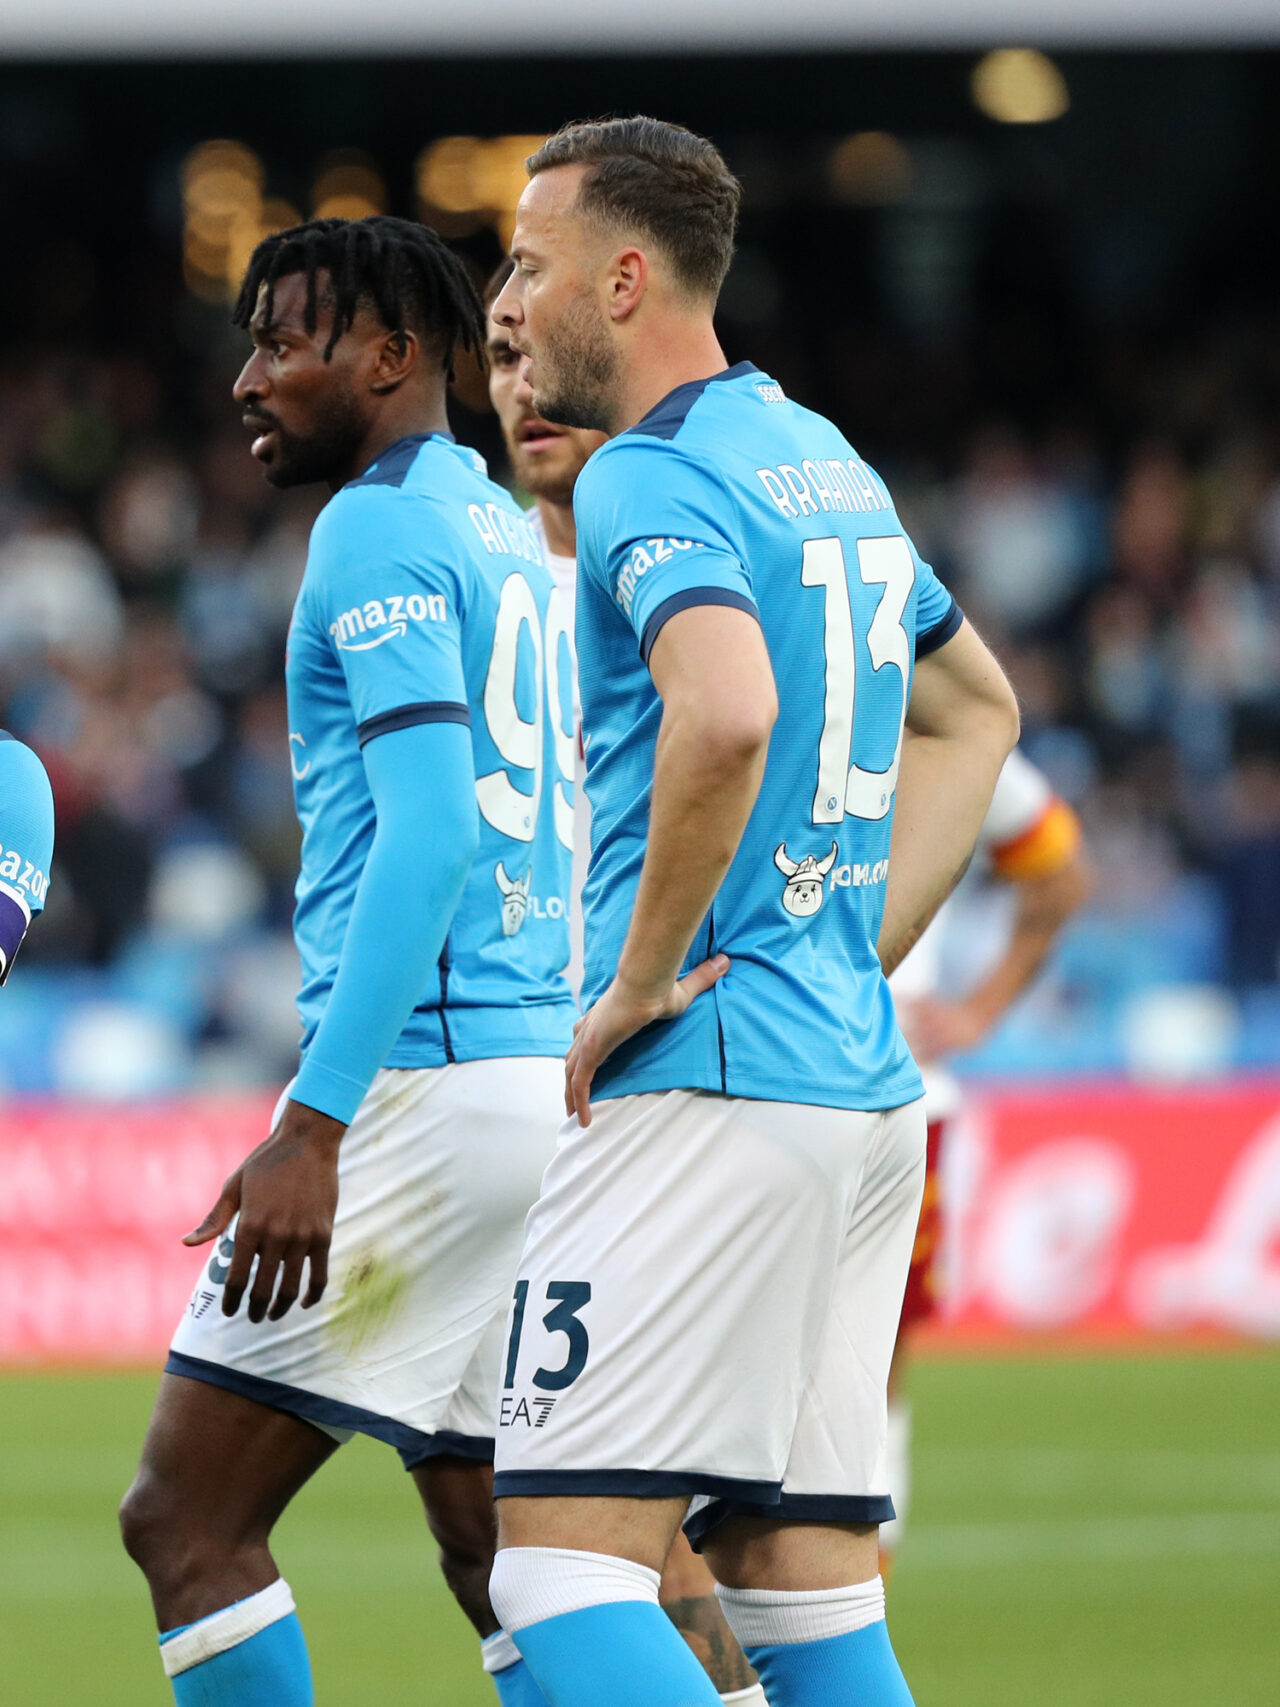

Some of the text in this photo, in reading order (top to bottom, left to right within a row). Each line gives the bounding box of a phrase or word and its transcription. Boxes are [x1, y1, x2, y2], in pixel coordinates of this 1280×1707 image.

[328, 593, 447, 650] amazon
[801, 536, 916, 825] 13
[503, 1280, 592, 1392] 13
[499, 1397, 557, 1428] EA7
